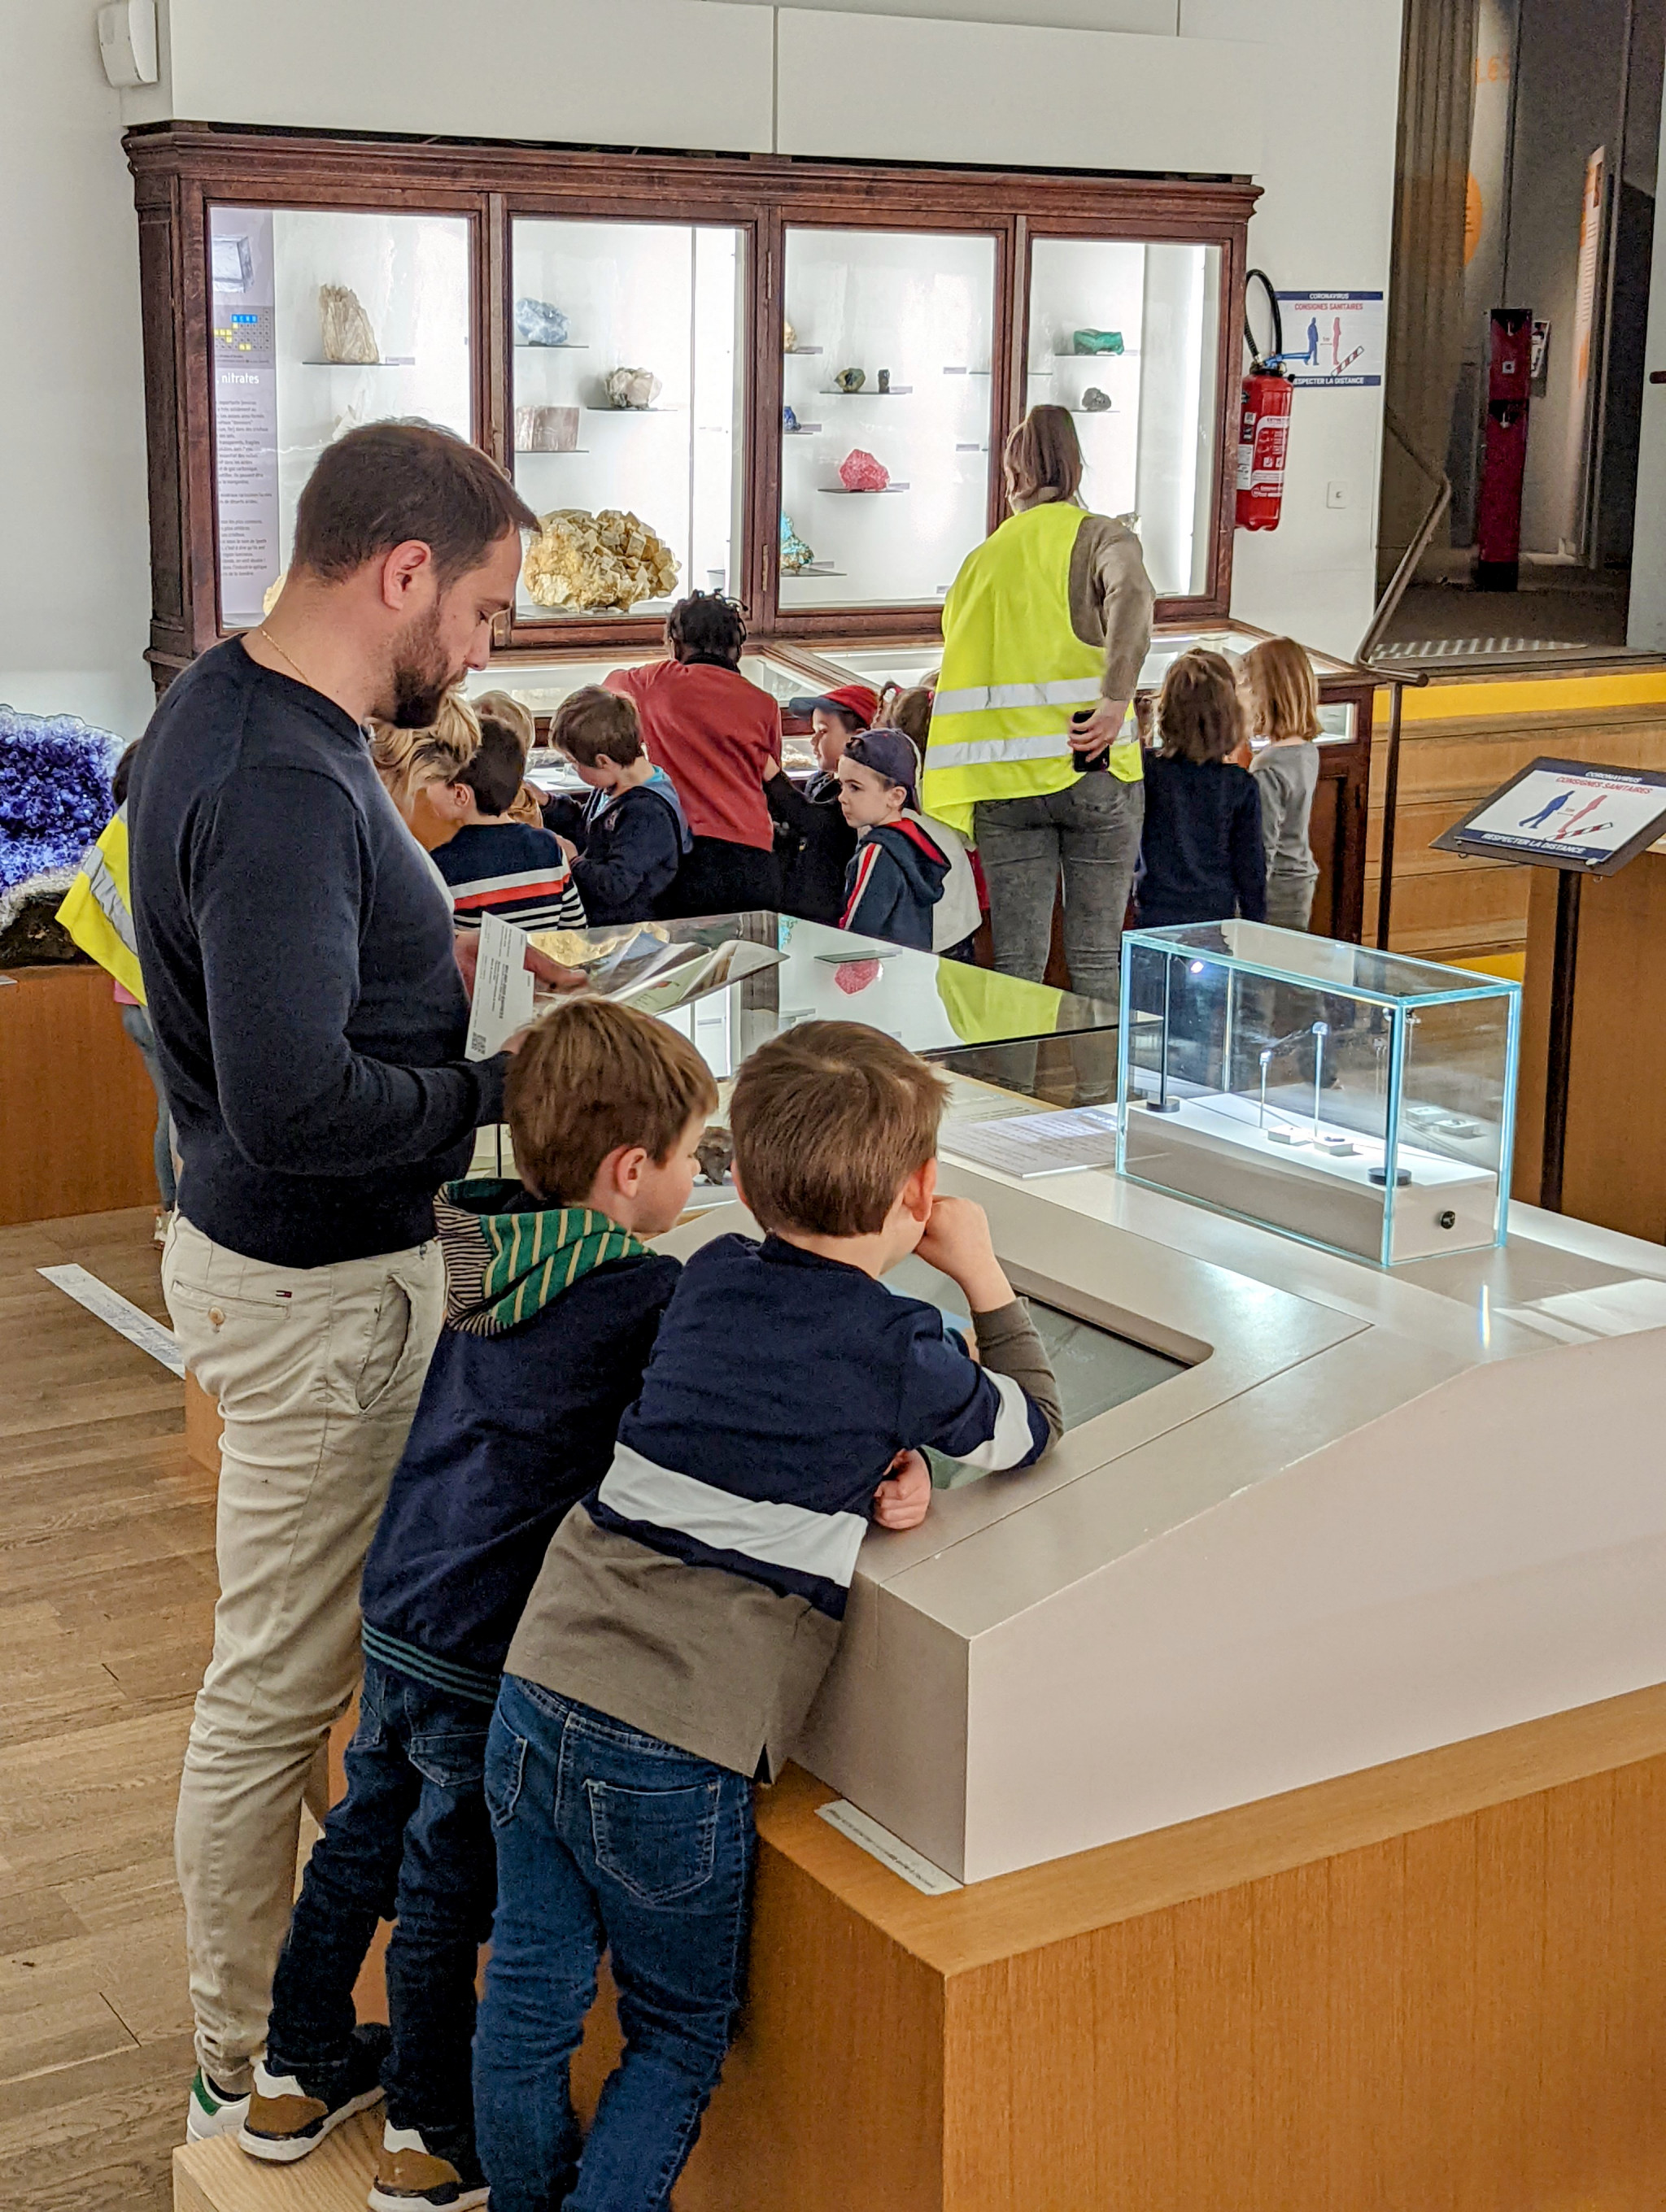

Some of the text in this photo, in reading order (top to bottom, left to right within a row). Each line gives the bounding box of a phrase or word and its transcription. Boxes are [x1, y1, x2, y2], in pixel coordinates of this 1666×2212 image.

[221, 372, 259, 384] nitrates
[1585, 771, 1642, 783] CORONAVIRUS
[1555, 777, 1653, 795] CONSIGNES SANITAIRES
[1481, 833, 1530, 846] RESPECTER
[1541, 841, 1586, 854] DISTANCE
